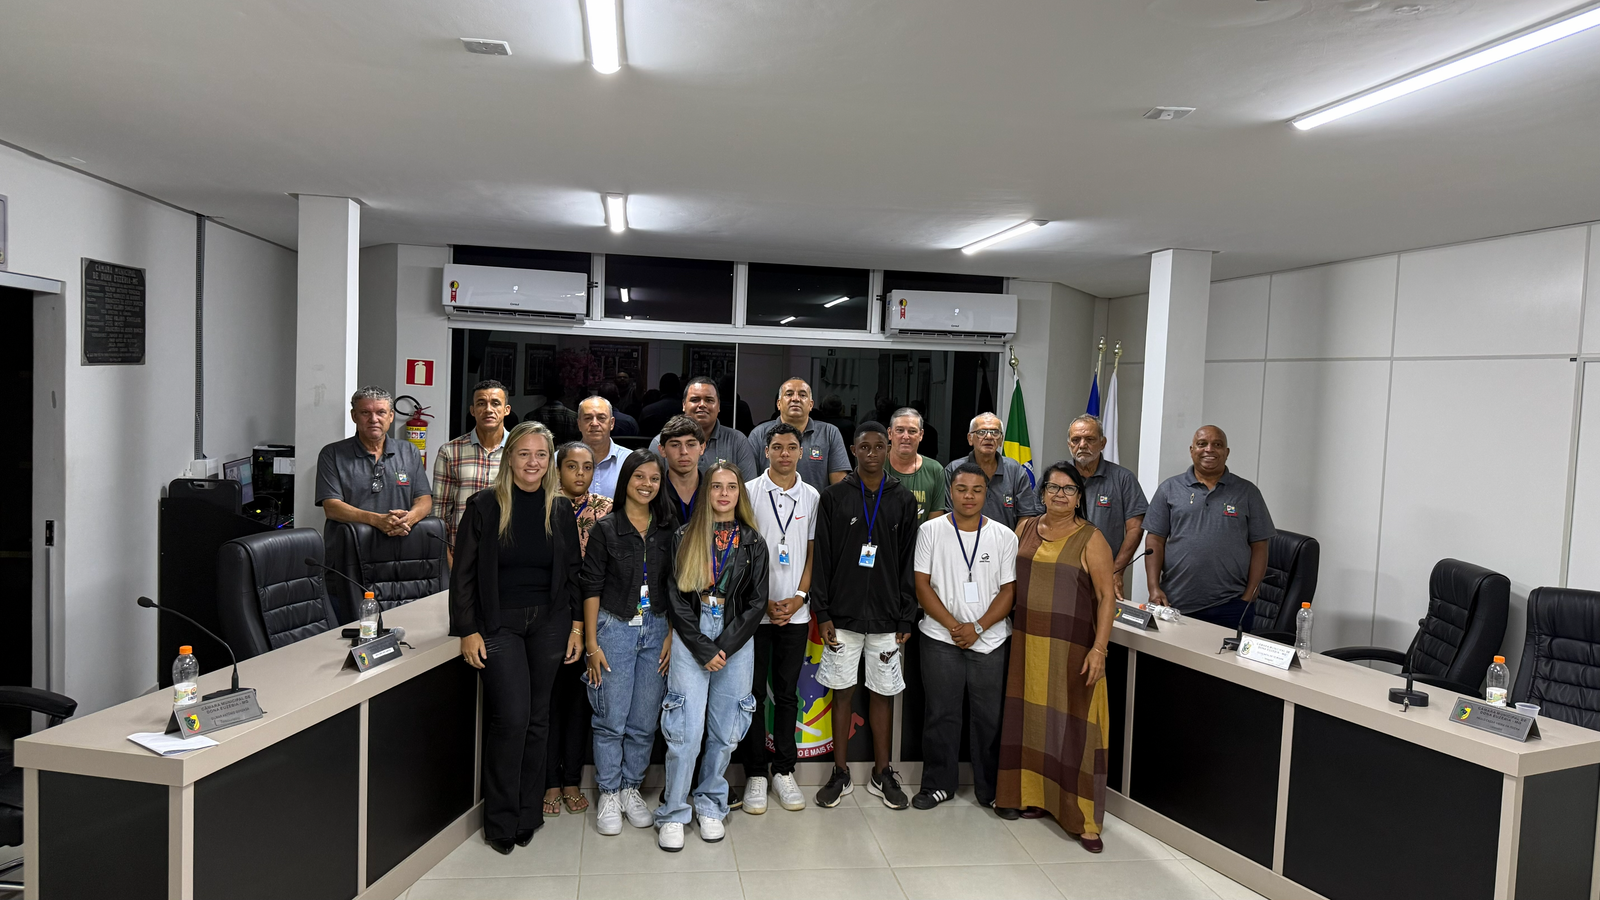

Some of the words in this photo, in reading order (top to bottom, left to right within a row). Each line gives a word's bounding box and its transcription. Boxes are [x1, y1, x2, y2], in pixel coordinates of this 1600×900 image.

[201, 702, 220, 711] CÂMARA
[220, 697, 244, 706] MUNICIPAL
[811, 746, 826, 756] MAIS
